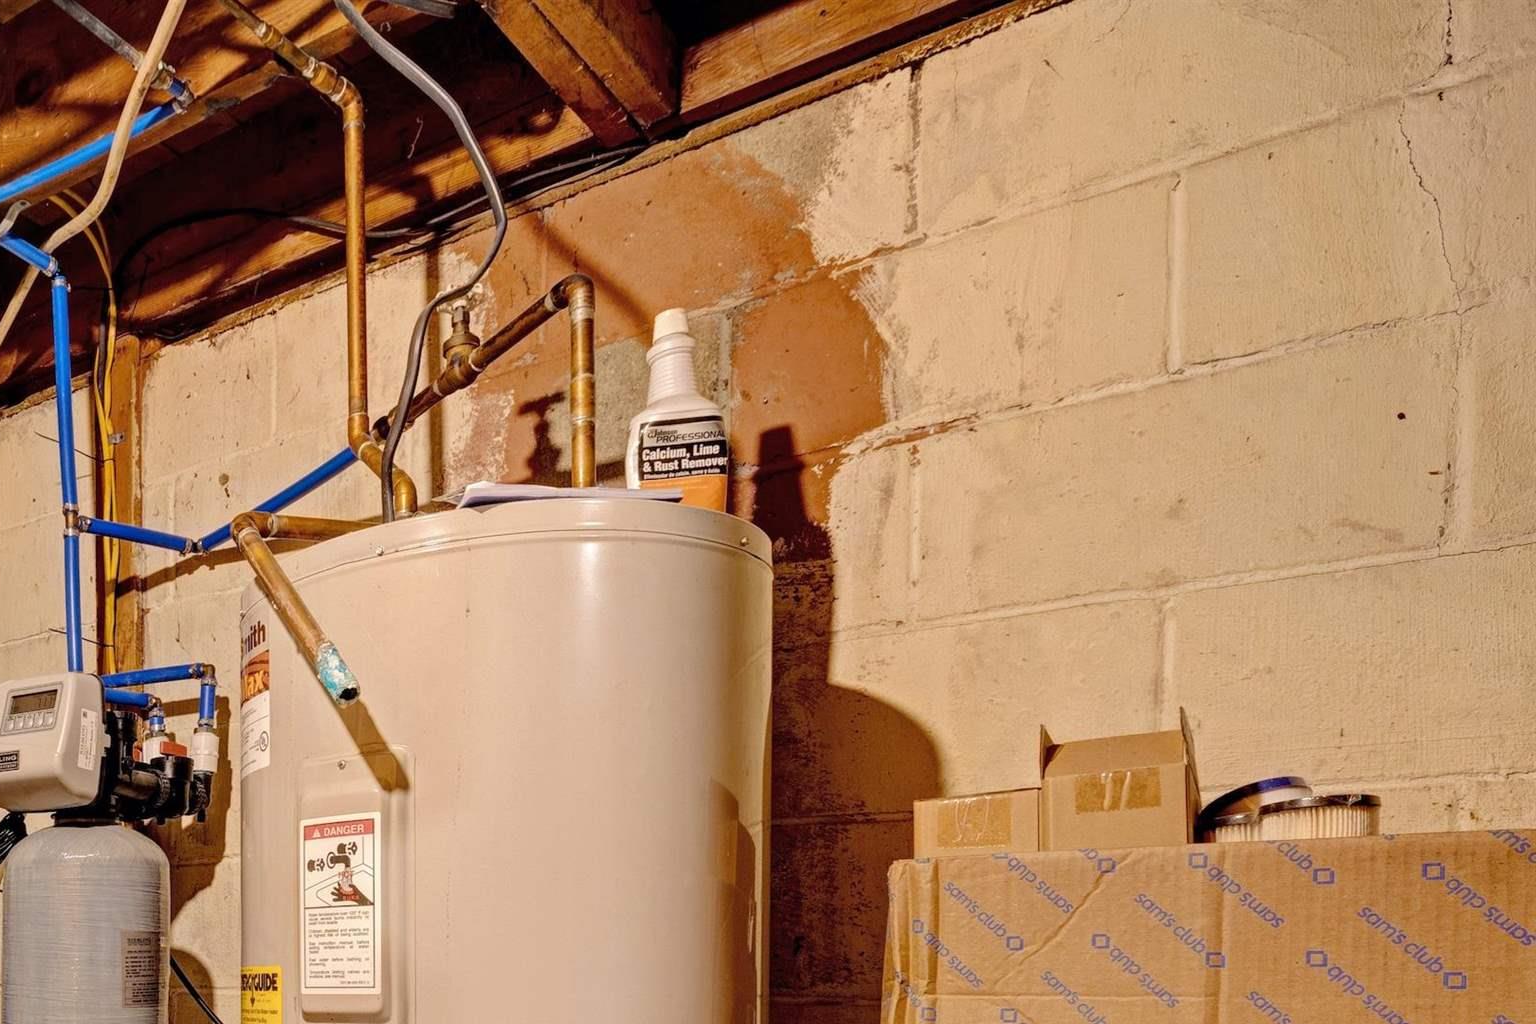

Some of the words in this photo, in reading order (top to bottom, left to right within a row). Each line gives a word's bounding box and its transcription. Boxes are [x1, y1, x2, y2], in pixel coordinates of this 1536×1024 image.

[642, 447, 690, 460] Calcium,
[693, 444, 720, 456] Lime
[643, 461, 652, 472] &
[654, 460, 679, 471] Rust
[681, 457, 728, 469] Remover
[323, 824, 365, 837] DANGER
[1007, 856, 1037, 884] club
[1277, 842, 1313, 871] club
[1207, 865, 1242, 894] club
[1445, 878, 1486, 909] club
[944, 881, 979, 914] sam's
[977, 910, 1007, 937] club
[1036, 880, 1074, 914] sam's
[1239, 892, 1285, 928] sam's
[1135, 893, 1176, 928] sam's
[1173, 927, 1207, 954] club
[1483, 906, 1536, 946] sam's
[924, 932, 950, 960] club
[1357, 907, 1407, 945] sam's
[1404, 943, 1444, 973] club
[948, 955, 984, 989] sam's
[1110, 945, 1141, 975] club
[1041, 971, 1078, 1005] sam's
[1139, 973, 1180, 1009] sam's
[1328, 965, 1365, 996] club
